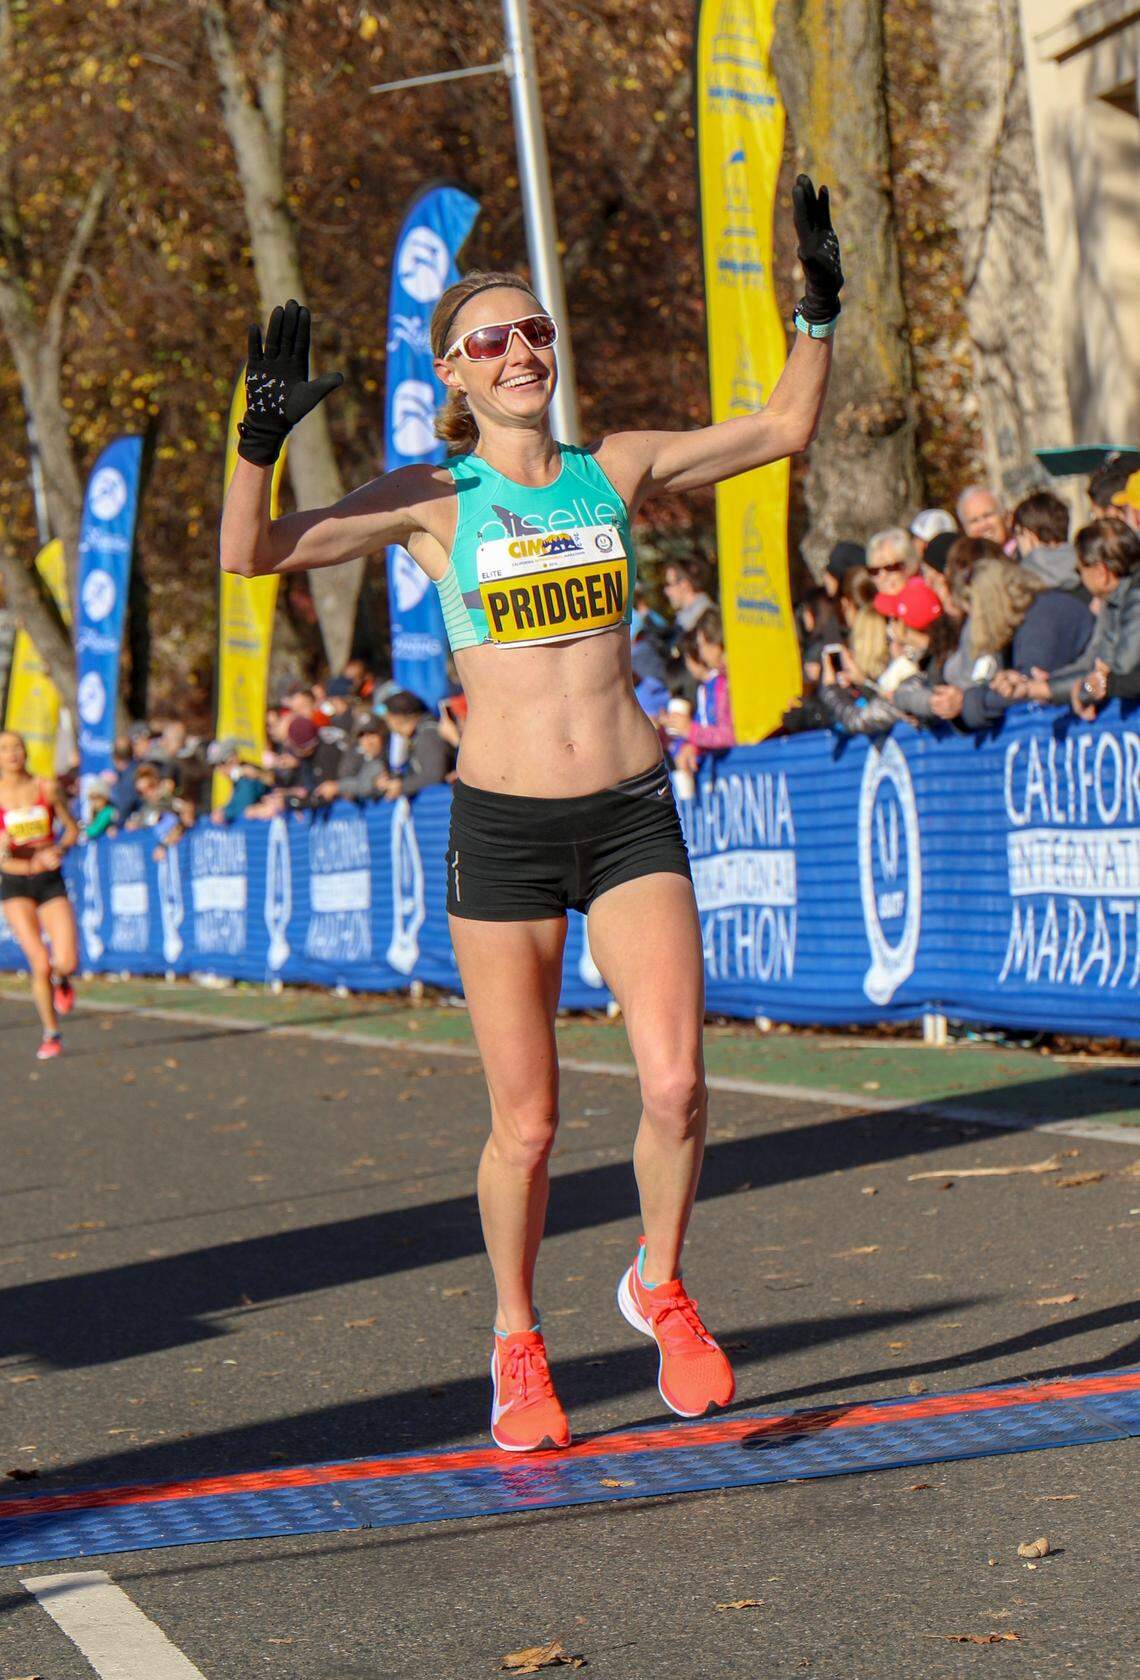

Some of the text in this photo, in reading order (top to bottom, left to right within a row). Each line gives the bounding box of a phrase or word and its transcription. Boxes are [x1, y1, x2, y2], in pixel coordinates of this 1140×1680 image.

[508, 538, 545, 558] CIM
[482, 569, 502, 579] ELITE
[487, 571, 623, 632] PRIDGEN
